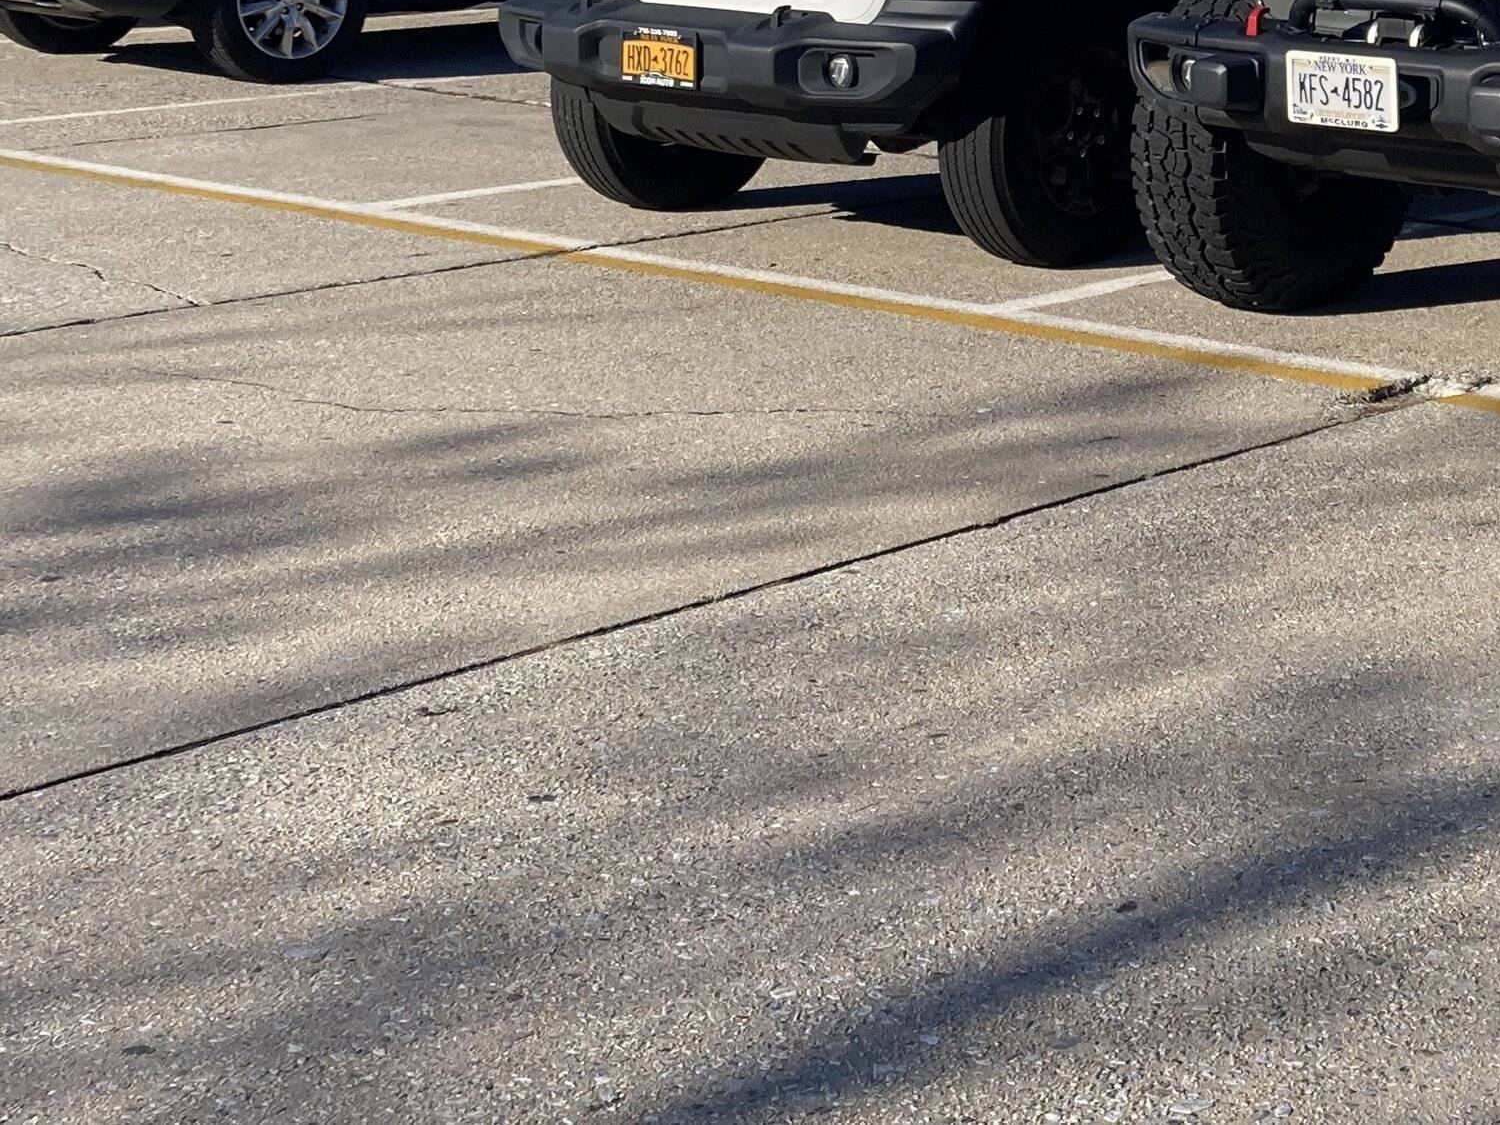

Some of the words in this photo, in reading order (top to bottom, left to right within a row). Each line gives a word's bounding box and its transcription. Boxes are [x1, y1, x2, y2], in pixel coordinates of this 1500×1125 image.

[627, 44, 651, 71] HXD
[660, 47, 689, 76] 3762
[1314, 61, 1336, 72] NEW
[1339, 62, 1367, 75] YORK
[1299, 72, 1329, 106] KFS
[1342, 77, 1385, 112] 4582
